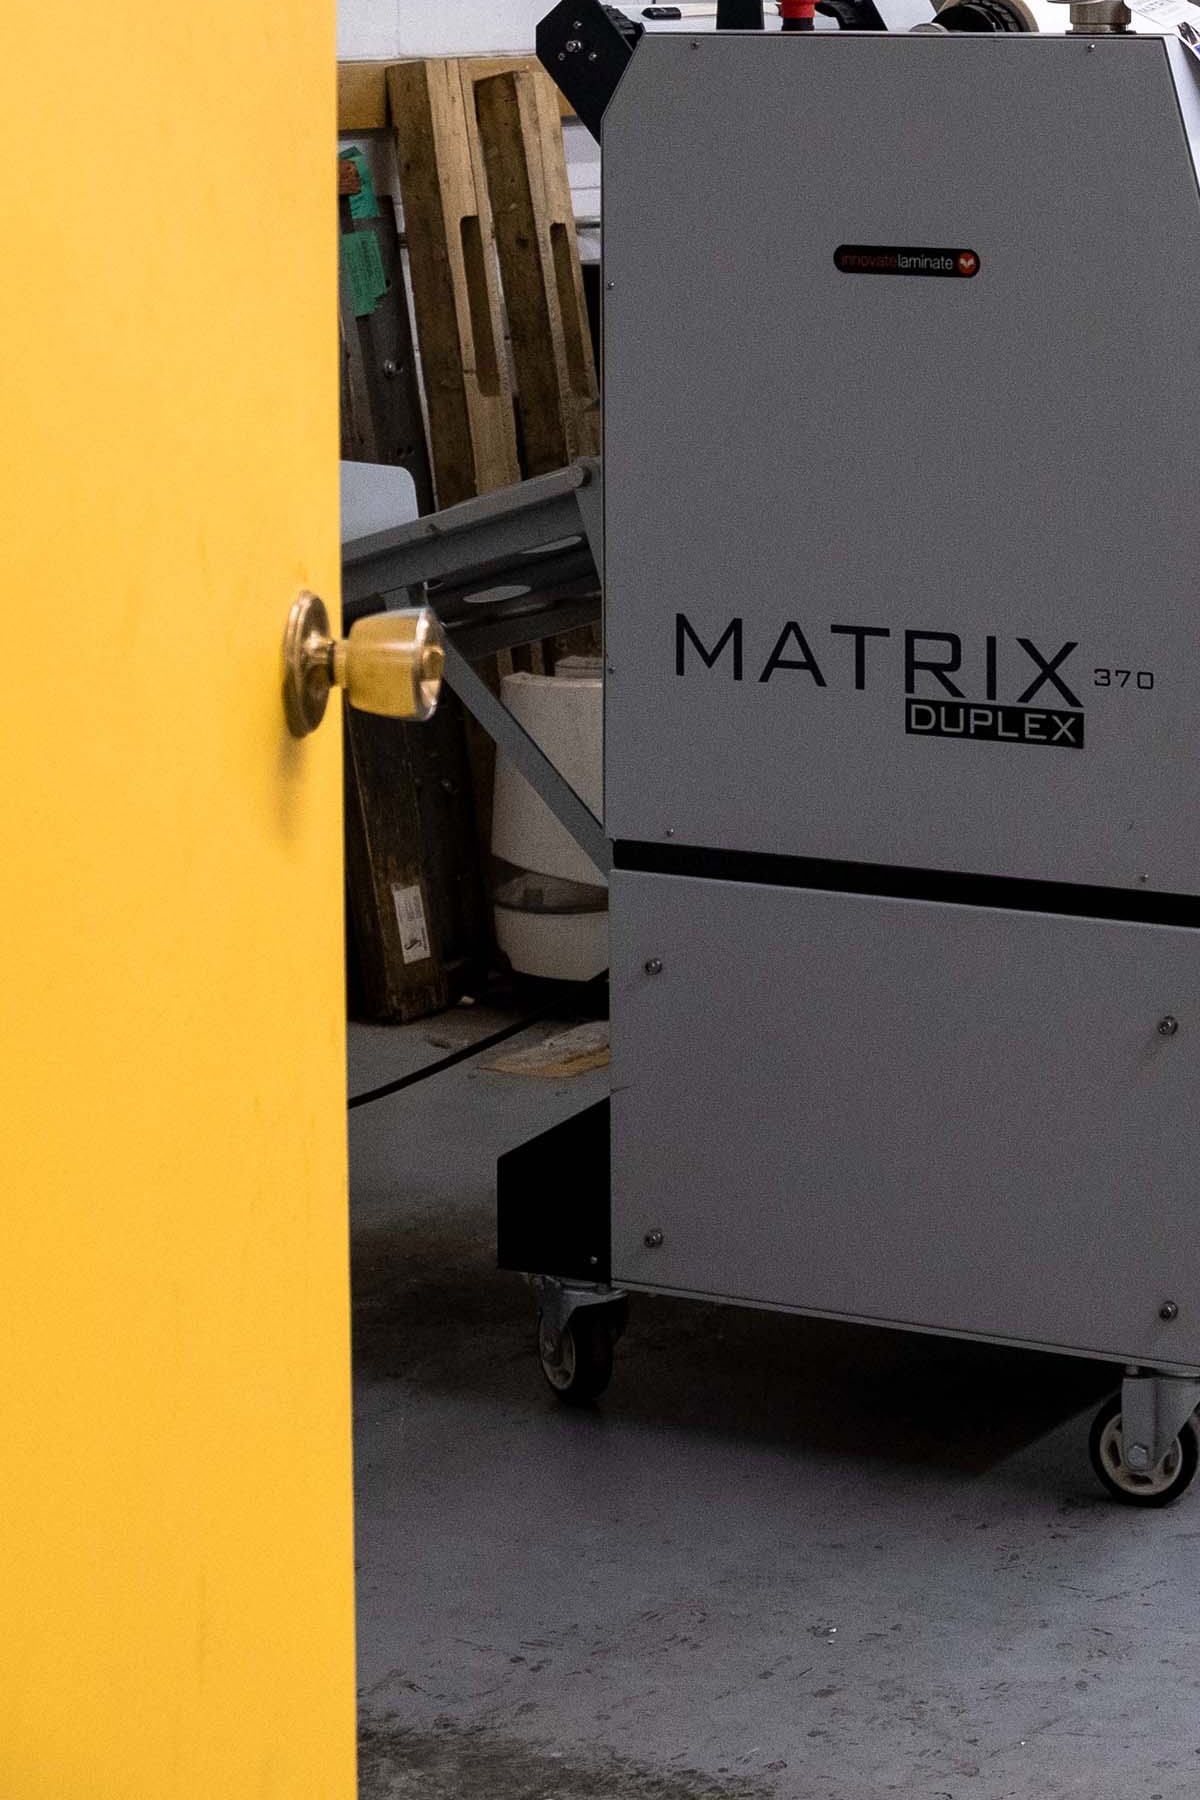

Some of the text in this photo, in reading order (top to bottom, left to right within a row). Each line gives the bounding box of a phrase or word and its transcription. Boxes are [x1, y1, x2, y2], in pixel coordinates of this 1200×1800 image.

[841, 253, 954, 270] innovatelaminate
[676, 612, 1155, 708] MATRIX 370
[910, 703, 1077, 744] DUPLEX
